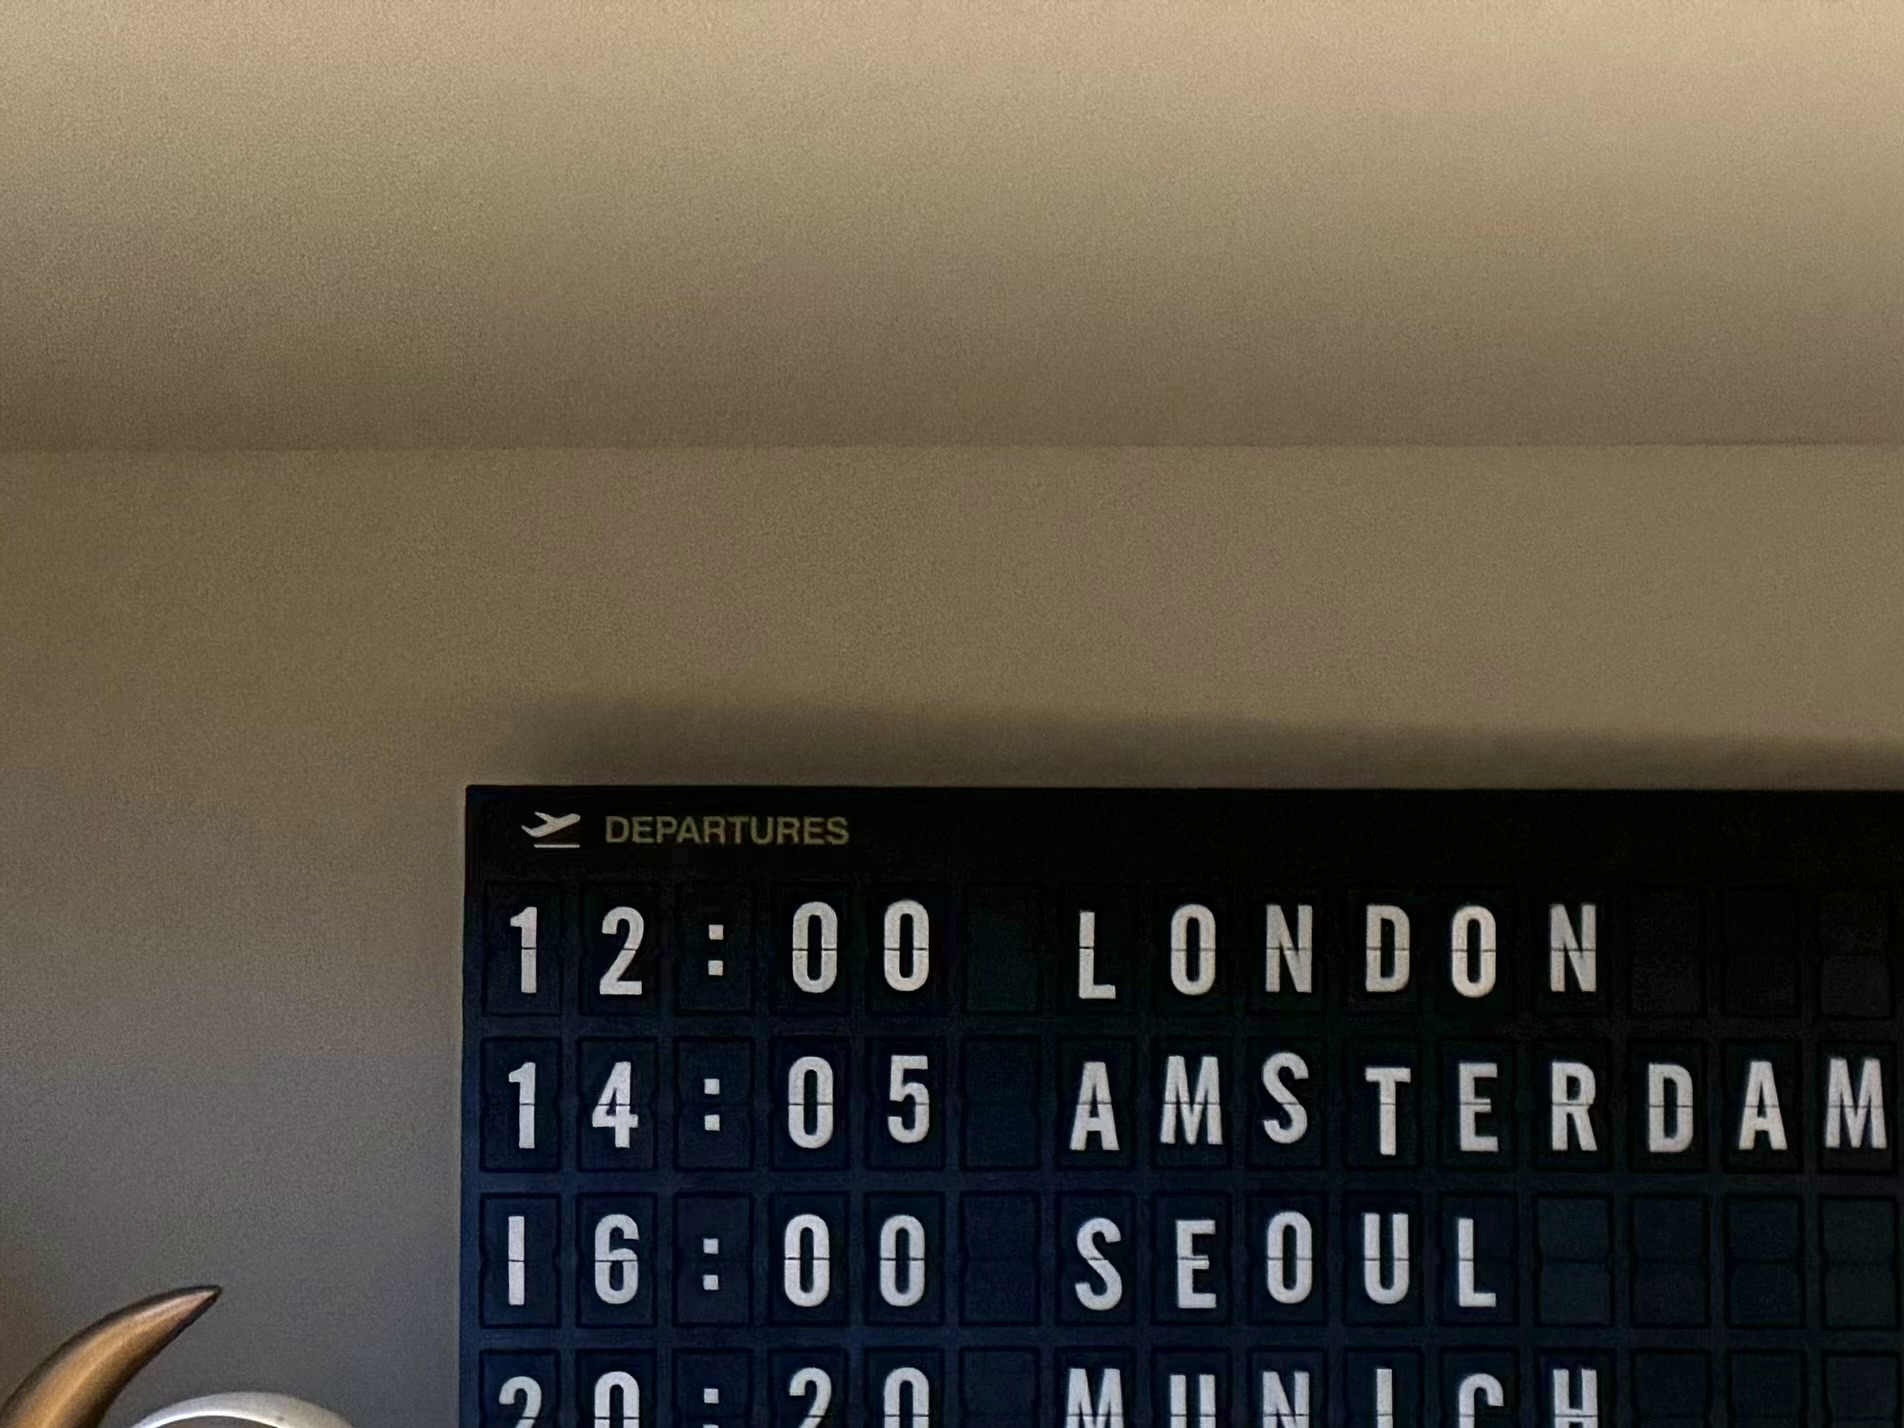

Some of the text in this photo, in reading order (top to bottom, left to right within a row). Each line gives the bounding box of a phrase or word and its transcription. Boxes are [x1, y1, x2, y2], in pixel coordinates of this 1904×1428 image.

[605, 815, 850, 847] DEPARTURES
[509, 899, 1597, 1000] 12:00 LONDON
[507, 1051, 1887, 1156] 14:05 AMSTERDAM
[1073, 1210, 1498, 1312] SEOUL
